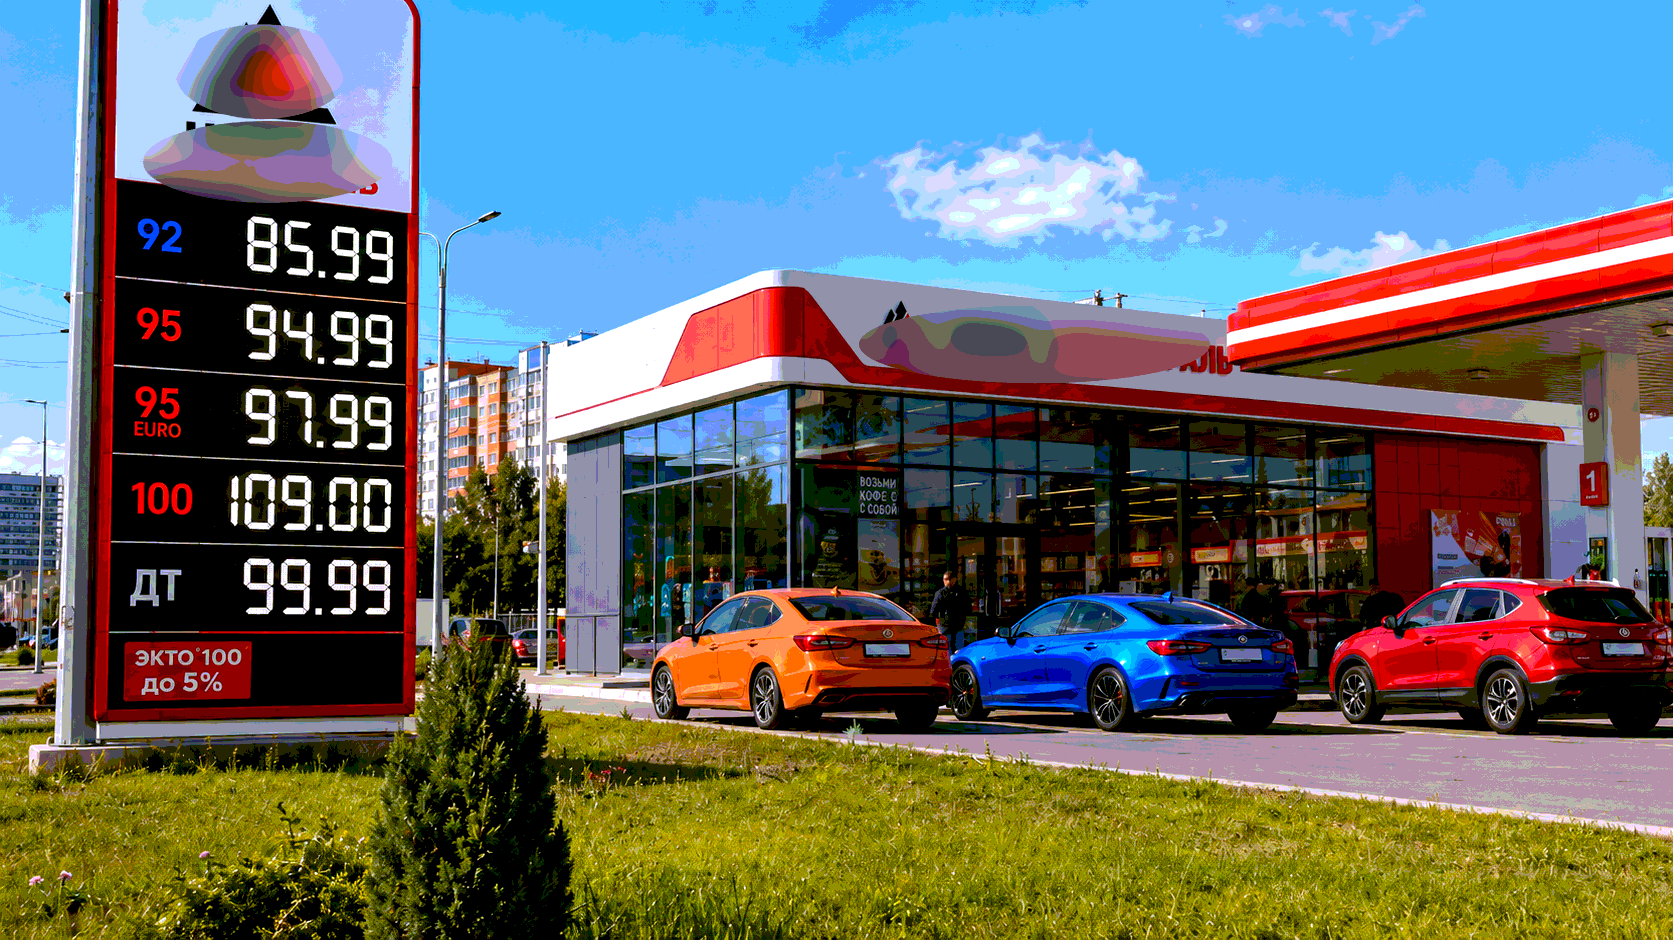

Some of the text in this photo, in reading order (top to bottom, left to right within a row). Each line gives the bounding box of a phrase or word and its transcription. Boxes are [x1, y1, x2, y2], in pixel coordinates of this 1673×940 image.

[138, 216, 393, 284] 92 85.99
[137, 303, 393, 369] 95 94.99
[134, 421, 181, 438] EURO
[135, 386, 392, 450] 95 97.99
[860, 476, 897, 489] ВОЗЬМИ
[1586, 470, 1596, 492] 1
[131, 473, 391, 532] 100 109.00
[860, 490, 887, 502] КОФЕ
[860, 502, 898, 515] С СОБОЙ
[130, 558, 391, 615] ДТ 99.99
[135, 648, 242, 666] ЭКТО 100
[141, 671, 223, 696] до 5%
